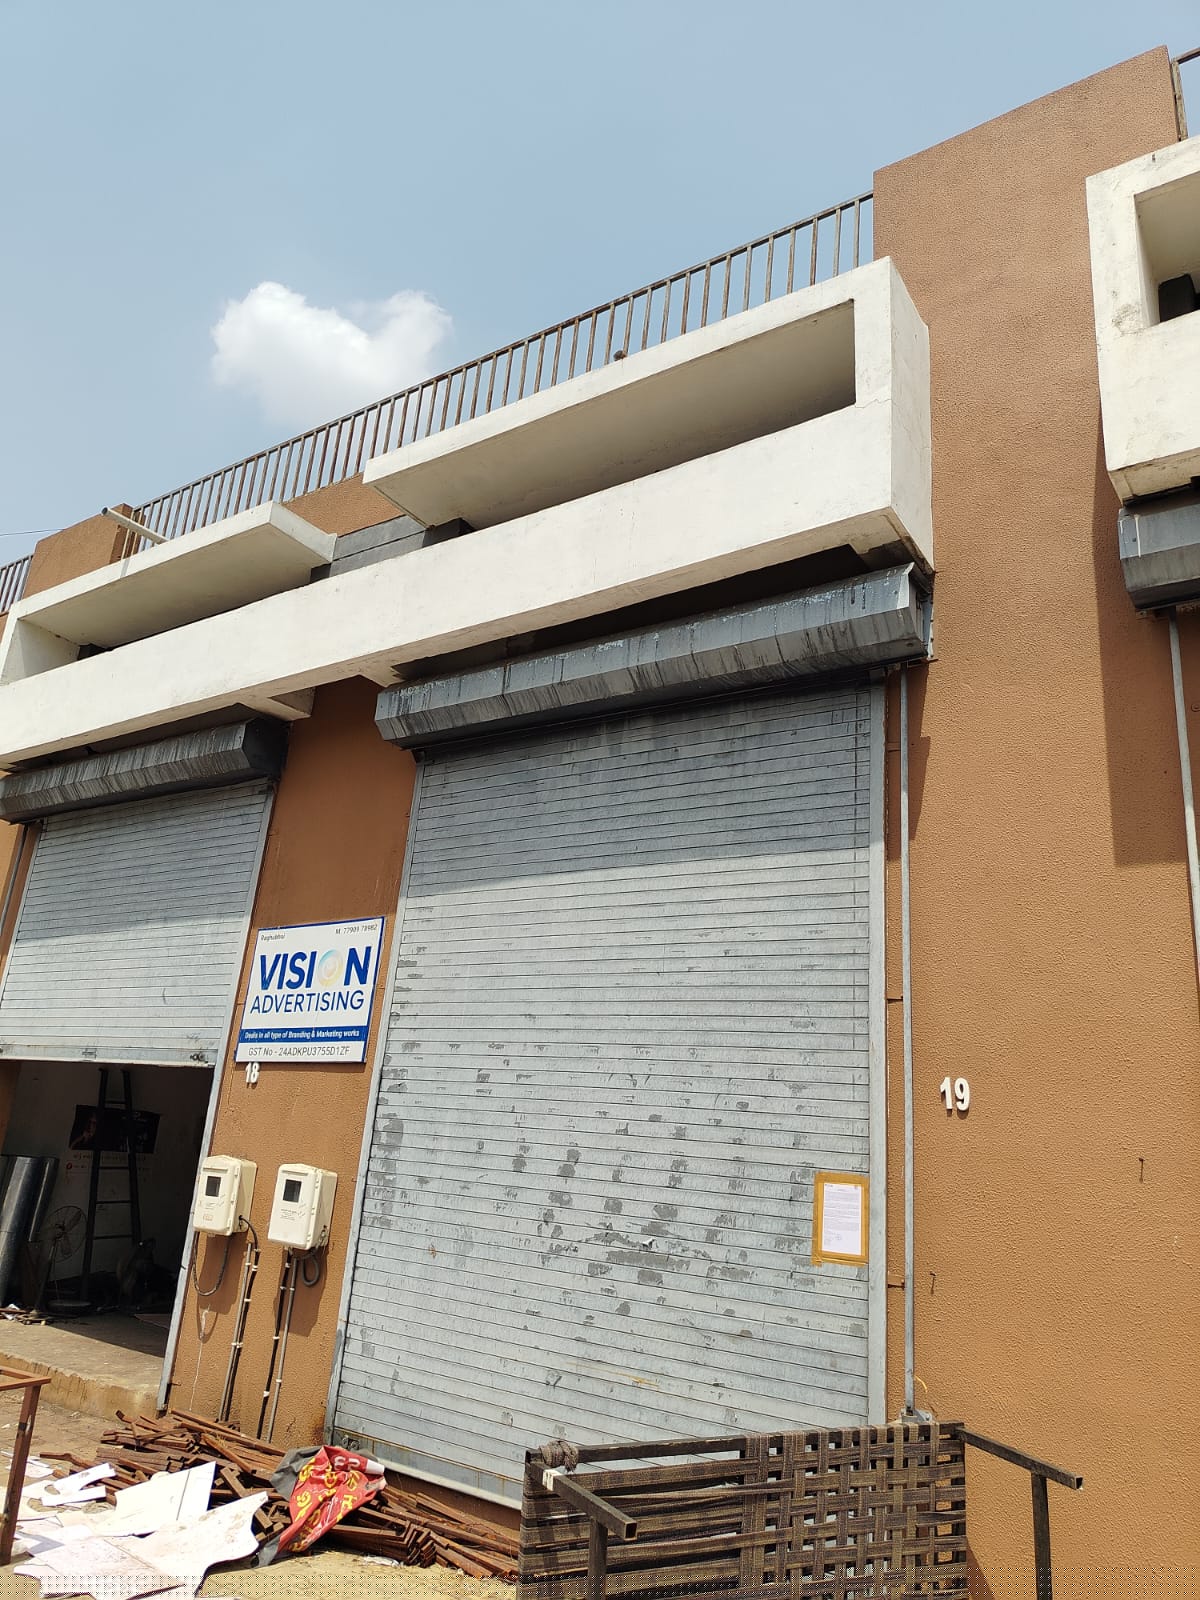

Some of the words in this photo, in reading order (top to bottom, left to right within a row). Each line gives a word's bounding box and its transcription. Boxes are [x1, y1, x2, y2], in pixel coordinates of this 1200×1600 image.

[259, 946, 372, 991] VISION
[250, 989, 365, 1014] ADVERTISING
[271, 1031, 282, 1040] type
[288, 1030, 311, 1040] Branding
[316, 1029, 343, 1039] Marketing
[248, 1047, 262, 1056] GST
[263, 1047, 273, 1056] No
[245, 1062, 260, 1084] 18
[940, 1076, 970, 1111] 19
